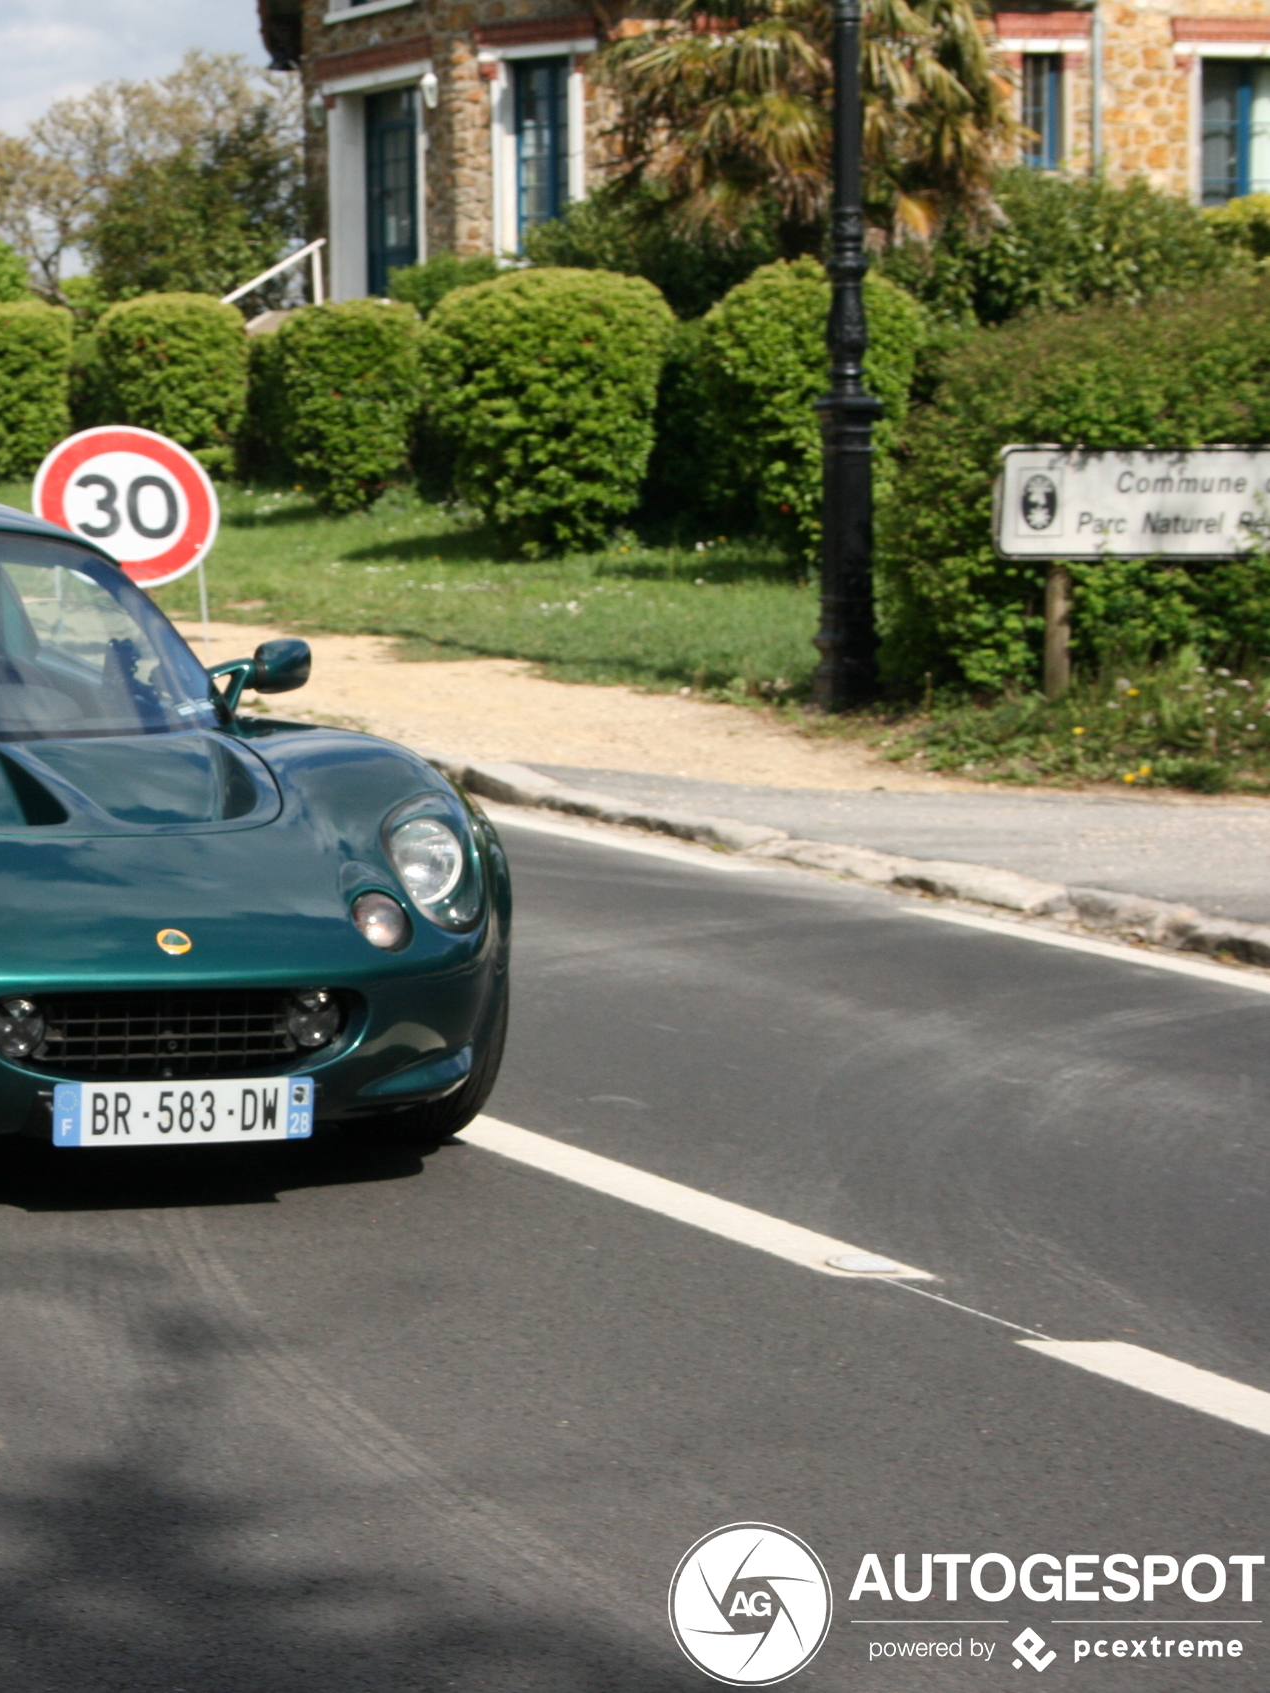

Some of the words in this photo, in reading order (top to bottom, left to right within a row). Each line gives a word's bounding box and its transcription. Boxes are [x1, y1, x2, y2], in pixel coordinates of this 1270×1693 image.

[1117, 470, 1247, 494] Commune
[75, 473, 179, 539] 30
[1077, 511, 1127, 534] Parc
[1142, 511, 1224, 535] Naturel
[61, 1118, 73, 1137] F
[289, 1112, 310, 1134] 2B
